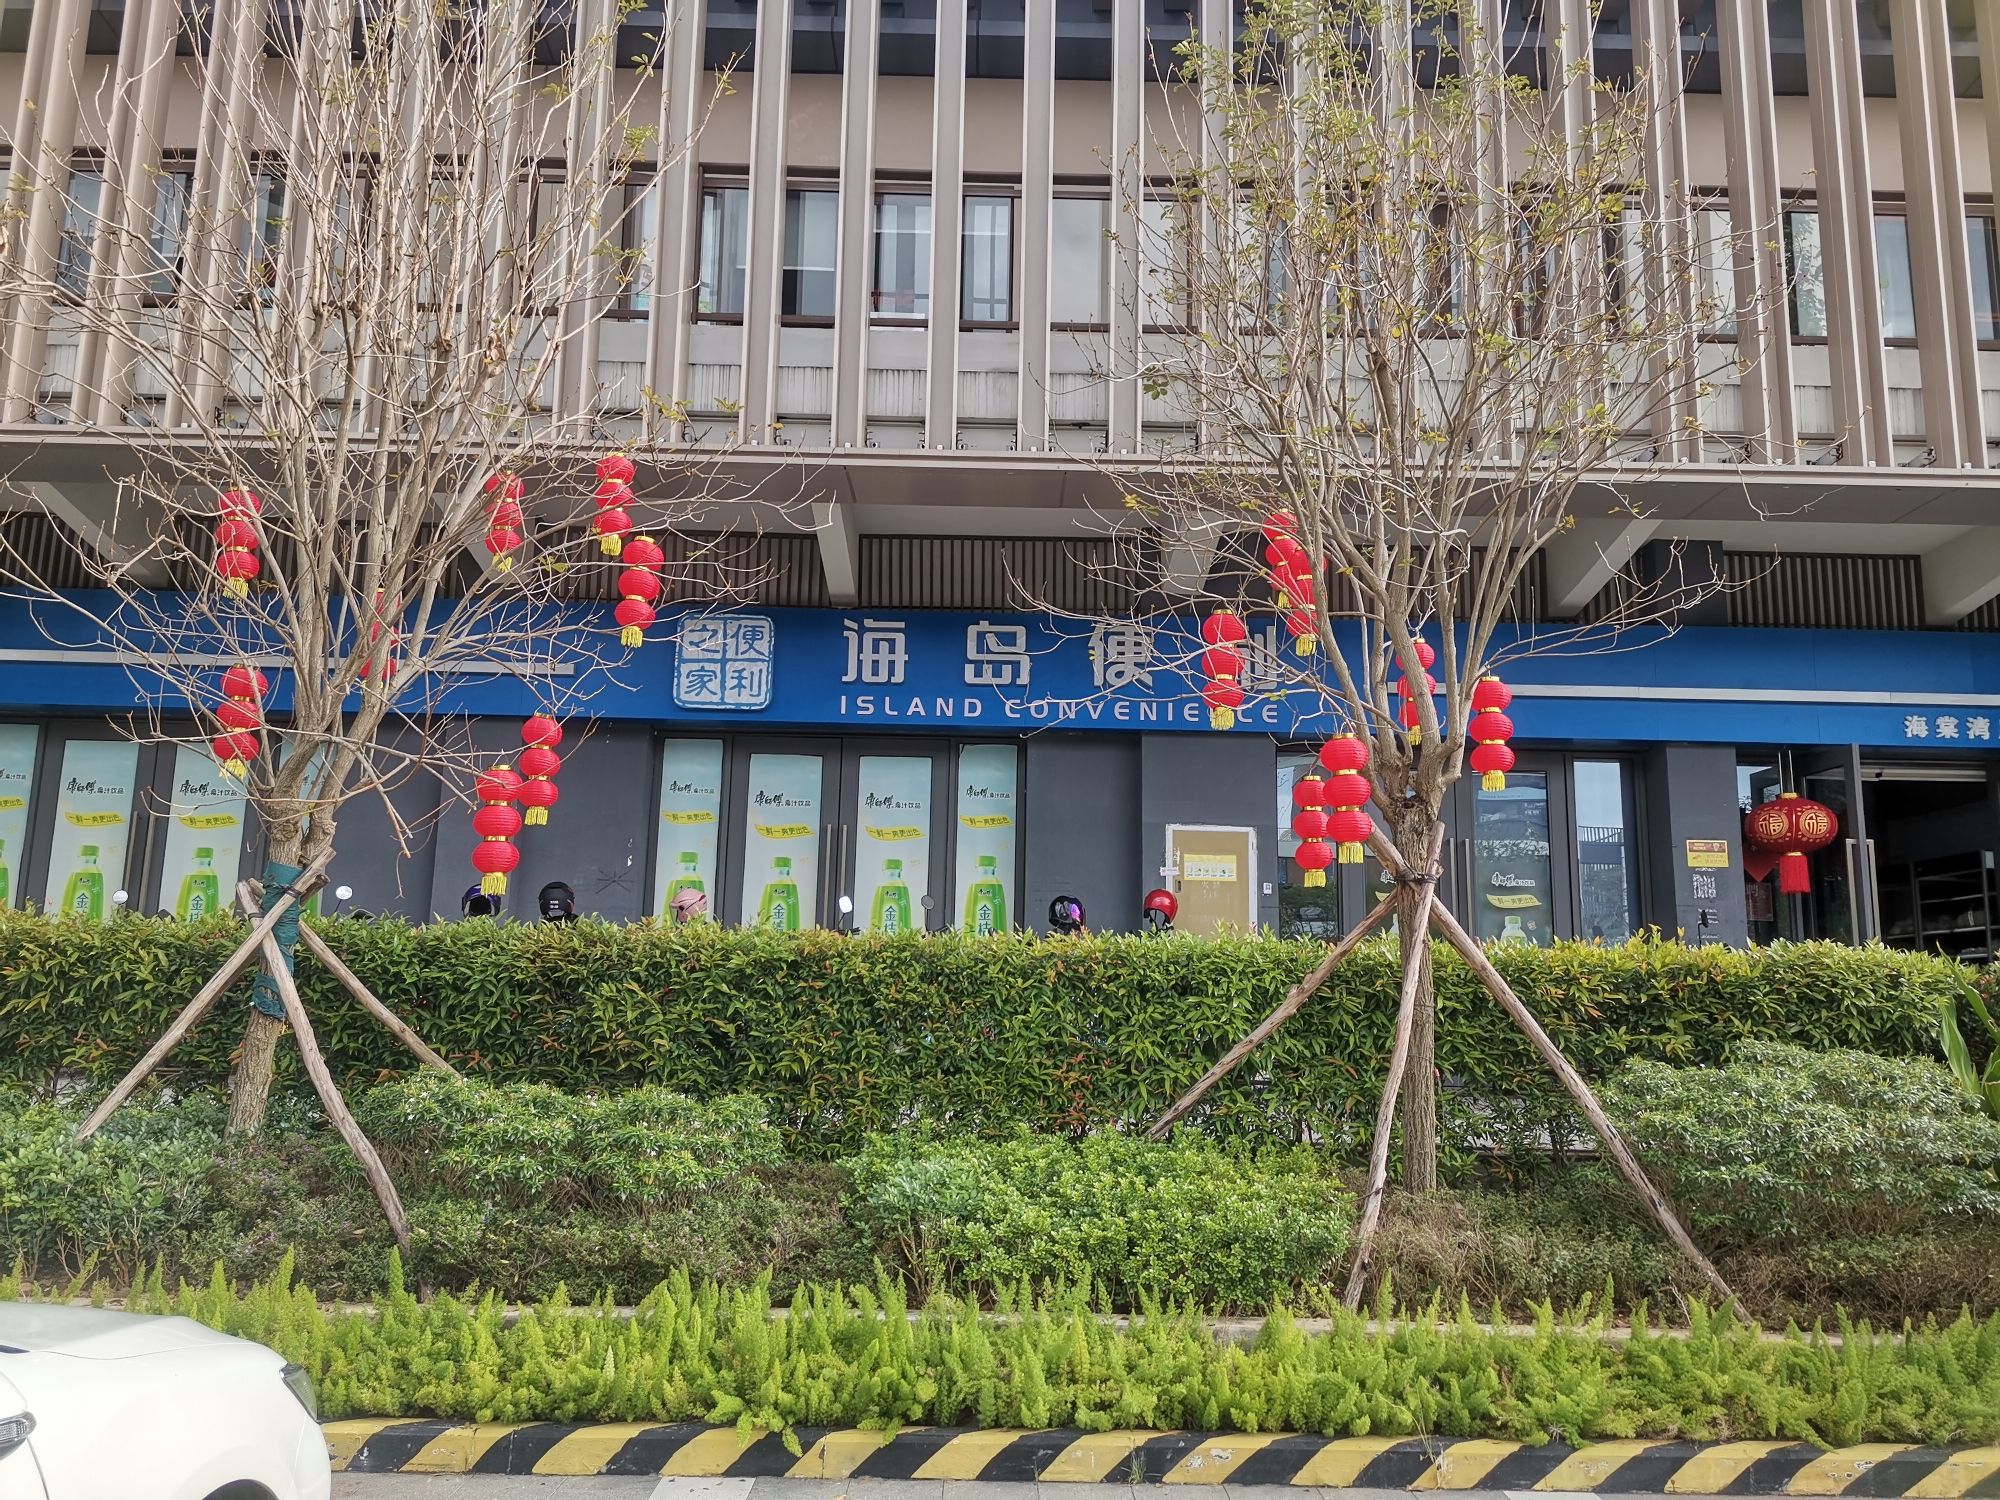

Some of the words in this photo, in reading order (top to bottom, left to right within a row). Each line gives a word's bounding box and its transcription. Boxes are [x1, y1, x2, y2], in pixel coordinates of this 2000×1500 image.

[684, 623, 721, 697] 之家
[729, 623, 767, 697] 便利
[840, 695, 982, 718] ISLAND
[1004, 698, 1278, 724] CONVENIECE
[1904, 715, 2000, 740] 海棠湾
[1758, 812, 1784, 836] 福
[1803, 812, 1829, 836] 福
